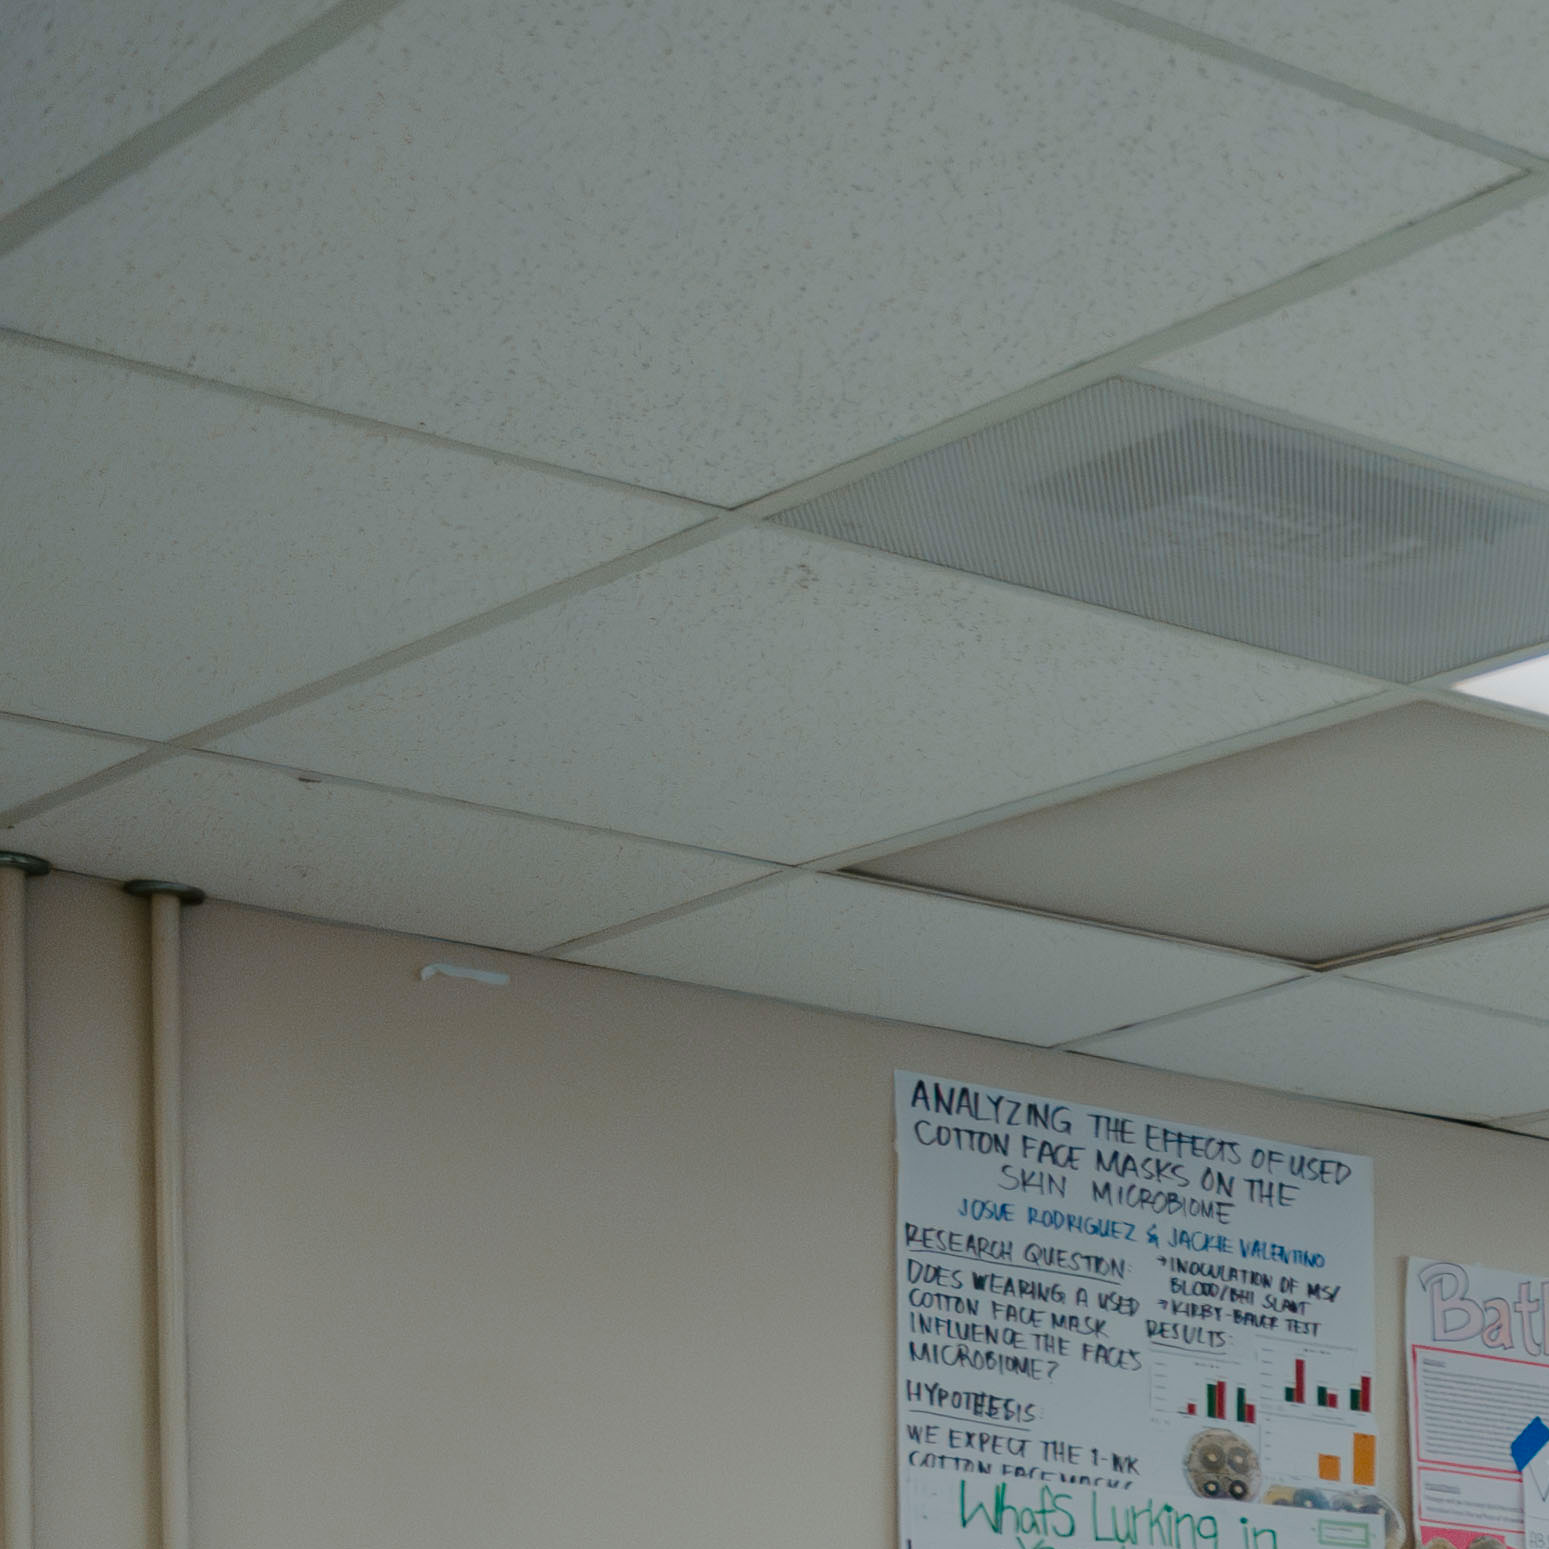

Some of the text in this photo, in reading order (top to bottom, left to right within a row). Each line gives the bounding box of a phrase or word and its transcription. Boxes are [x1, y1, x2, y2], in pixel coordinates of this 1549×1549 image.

[911, 1079, 1352, 1185] ANALYZING THE EFFECTS OF USED
[913, 1119, 1301, 1207] COTTON FACE MASKS ON THE
[997, 1164, 1235, 1224] SKIN MICROBIOME
[905, 1222, 1013, 1262] RESEARCH
[958, 1198, 1015, 1222] JOSUE
[1027, 1206, 1138, 1242] RODRIGUEZ
[1239, 1238, 1326, 1269] VALENTINO
[907, 1258, 1141, 1317] DOES WEARING A USED
[908, 1288, 1110, 1338] COTTON FACE MASK
[910, 1311, 1142, 1372] INFLUENCE THE FACES
[1285, 1319, 1322, 1337] TEST
[908, 1341, 1060, 1384] MICROBIOME?
[906, 1424, 1083, 1465] WE EXPECT THE
